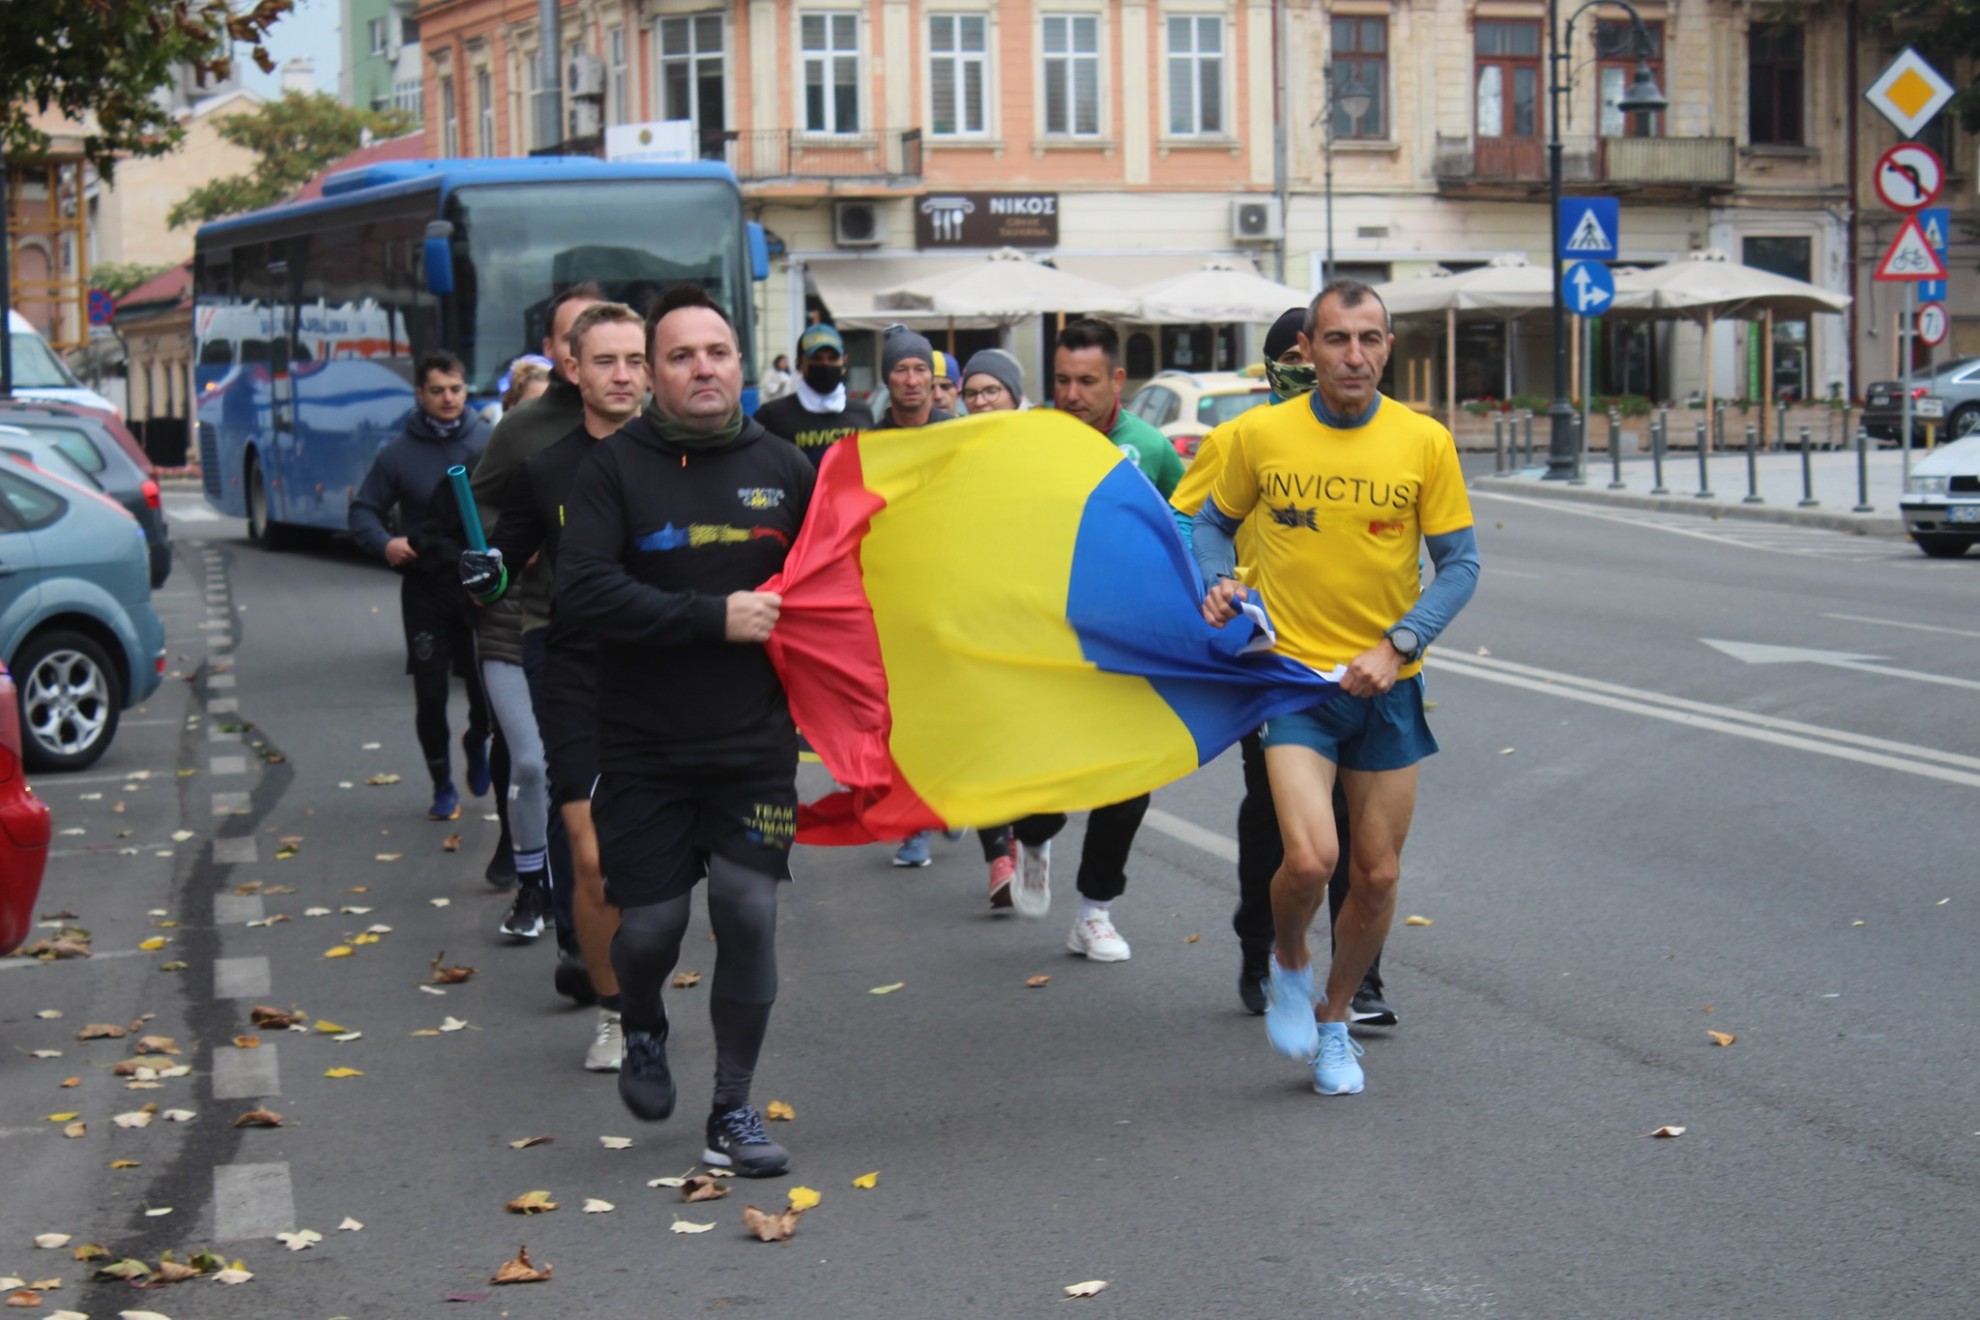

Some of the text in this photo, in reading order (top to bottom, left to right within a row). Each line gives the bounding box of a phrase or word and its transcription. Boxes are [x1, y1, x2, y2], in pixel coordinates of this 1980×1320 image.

[795, 427, 867, 448] INVICT
[1266, 473, 1410, 509] INVICTUS
[753, 803, 793, 821] TEAM
